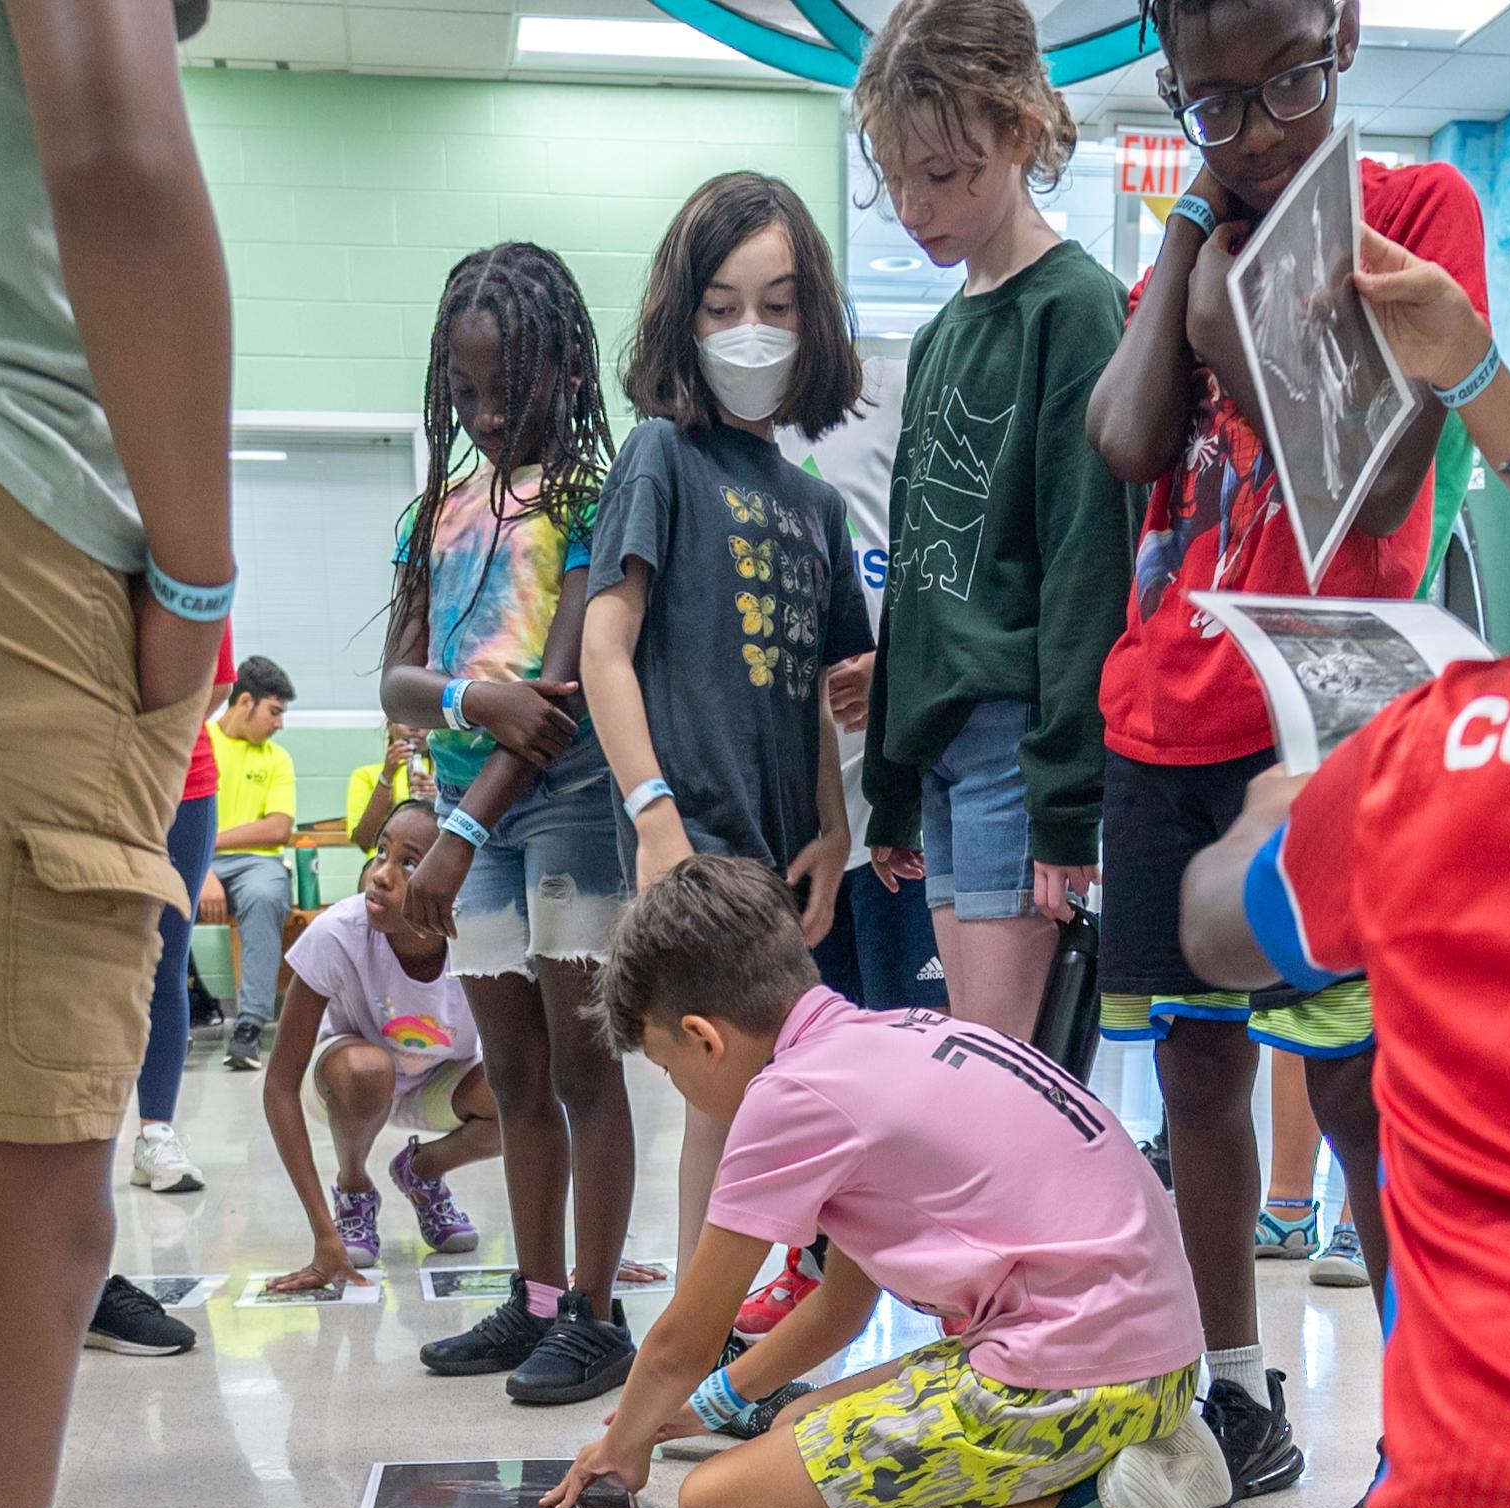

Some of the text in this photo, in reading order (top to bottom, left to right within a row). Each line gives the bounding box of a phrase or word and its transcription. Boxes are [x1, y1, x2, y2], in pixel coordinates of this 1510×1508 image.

[1122, 135, 1187, 195] EXIT
[1458, 366, 1490, 400] QUEST
[916, 969, 945, 981] adida
